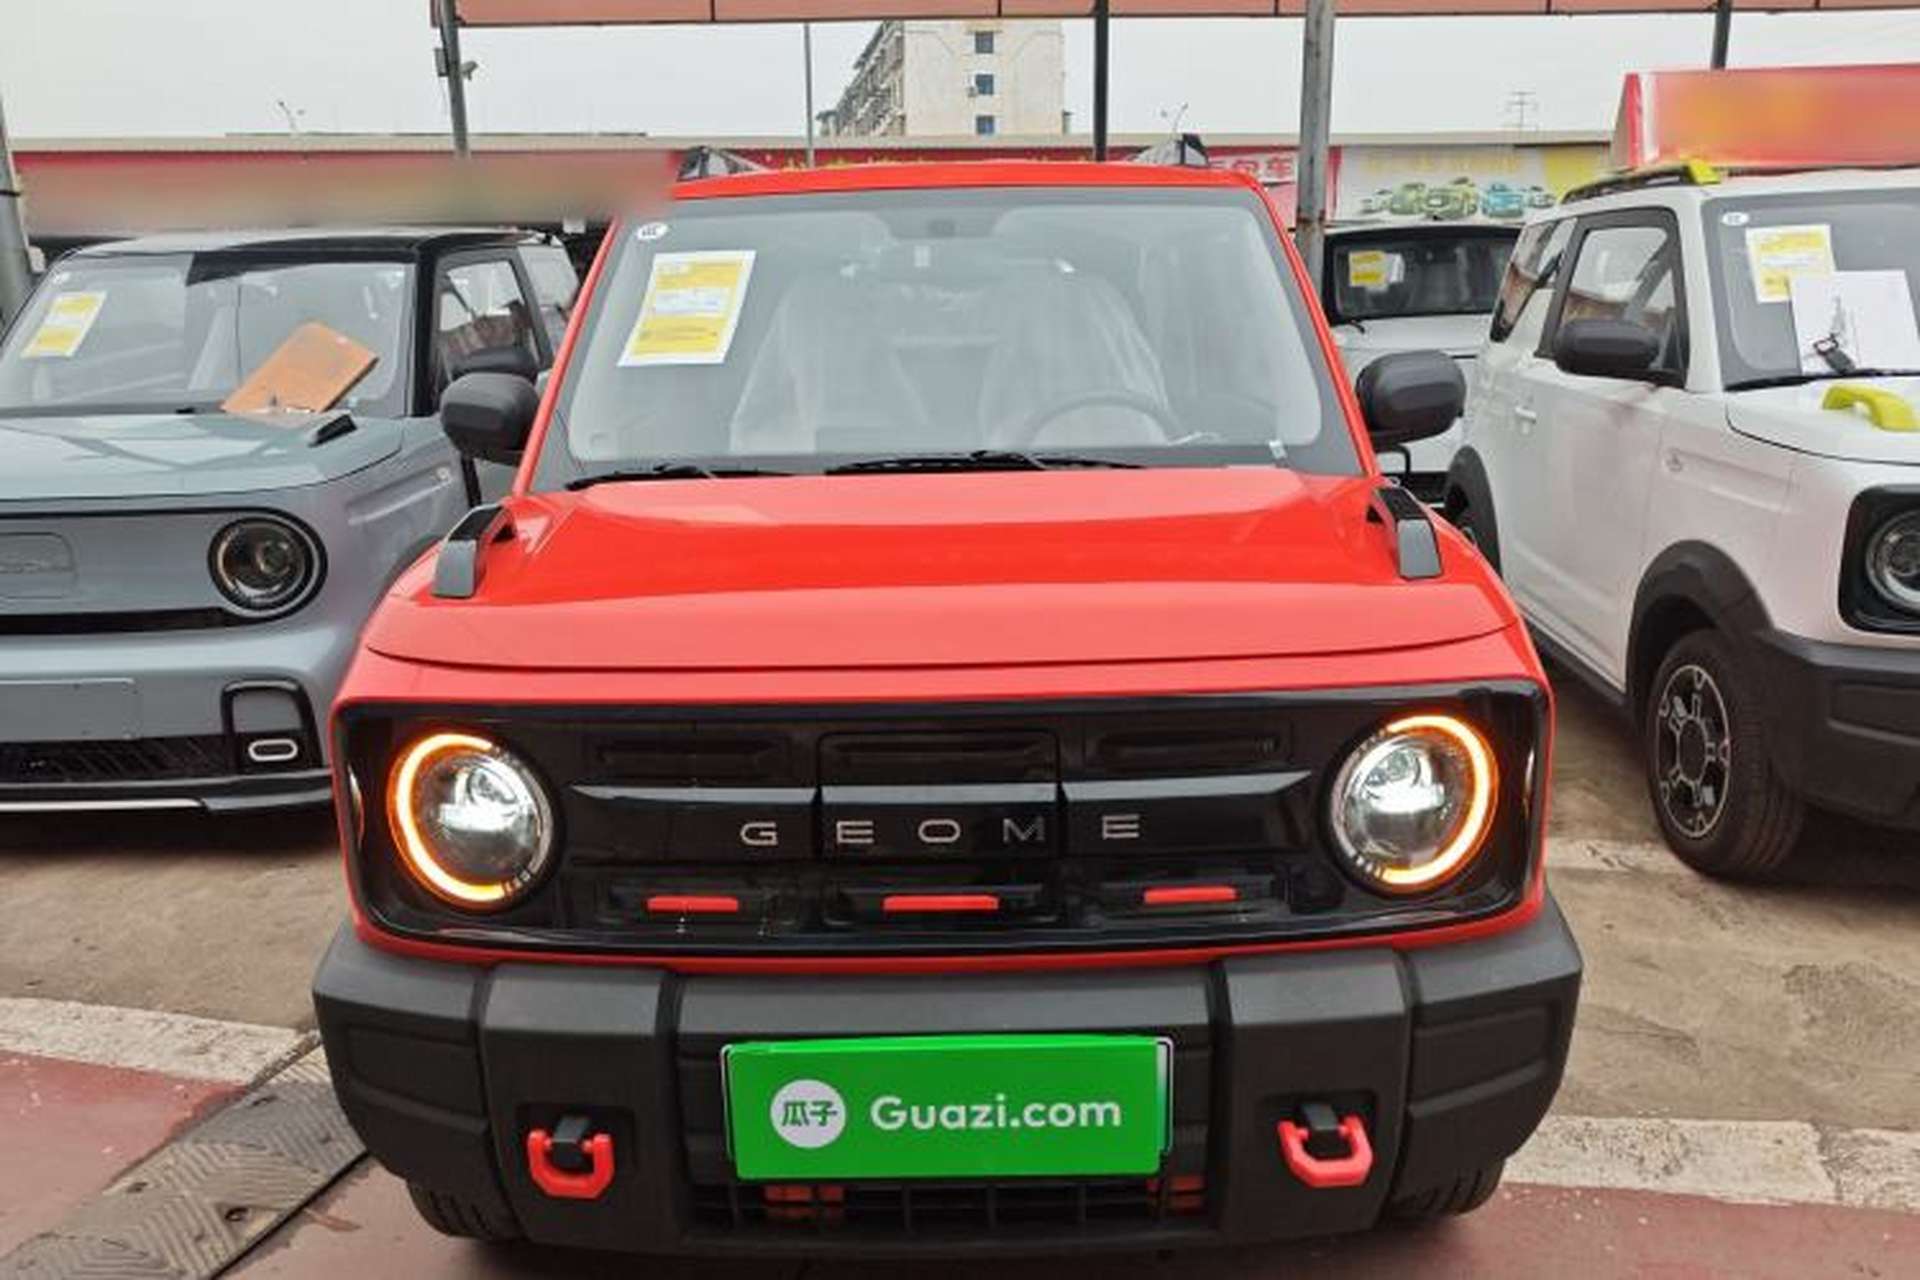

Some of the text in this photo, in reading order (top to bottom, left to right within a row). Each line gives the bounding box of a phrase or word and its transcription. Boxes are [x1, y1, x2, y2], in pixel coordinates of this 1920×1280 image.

[741, 814, 1141, 847] GEOME
[781, 1099, 838, 1127] 瓜子
[871, 1094, 1121, 1130] Guazi.com
